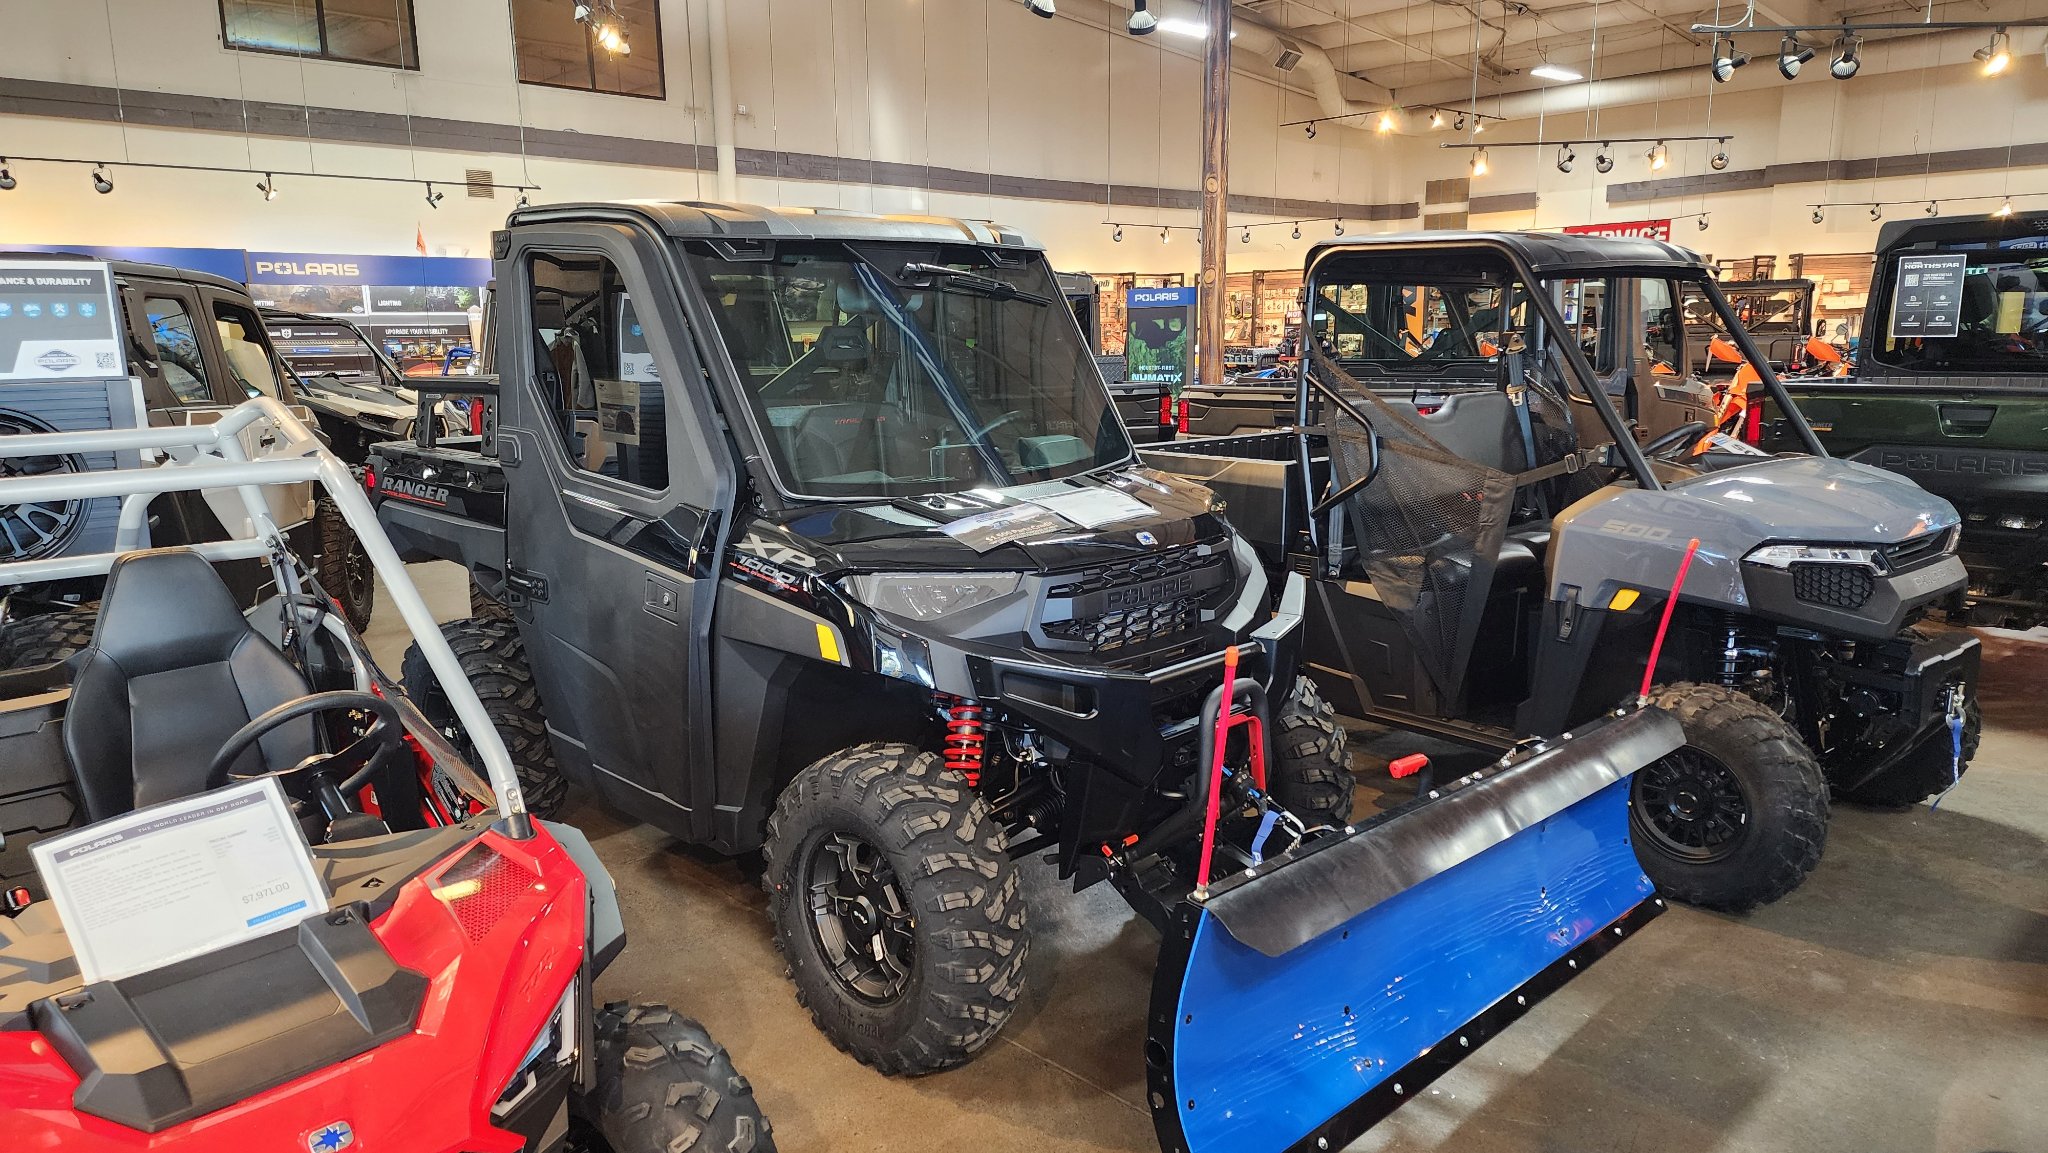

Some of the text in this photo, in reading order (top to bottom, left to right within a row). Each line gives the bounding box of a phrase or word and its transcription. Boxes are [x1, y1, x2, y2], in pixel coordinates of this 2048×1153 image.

[256, 261, 360, 276] POLARIS
[1904, 262, 1960, 270] NORTHSTAR
[27, 277, 35, 285] &
[36, 277, 92, 286] DURABILITY
[377, 299, 402, 307] LIGHTING
[1134, 292, 1180, 302] POLARIS
[1131, 371, 1183, 384] NUMATIX
[1880, 451, 2048, 477] POLARIS
[381, 476, 450, 502] RANGER
[1600, 519, 1673, 541] 500
[733, 532, 817, 568] XP
[739, 555, 796, 584] 1000
[1913, 566, 1953, 587] POLARIS
[1107, 575, 1193, 609] POLARIS
[69, 833, 124, 857] POLARIS
[153, 819, 178, 829] WORLD
[179, 812, 206, 822] LEADER
[230, 798, 249, 808] ROAD
[242, 881, 290, 904] $7,971.00
